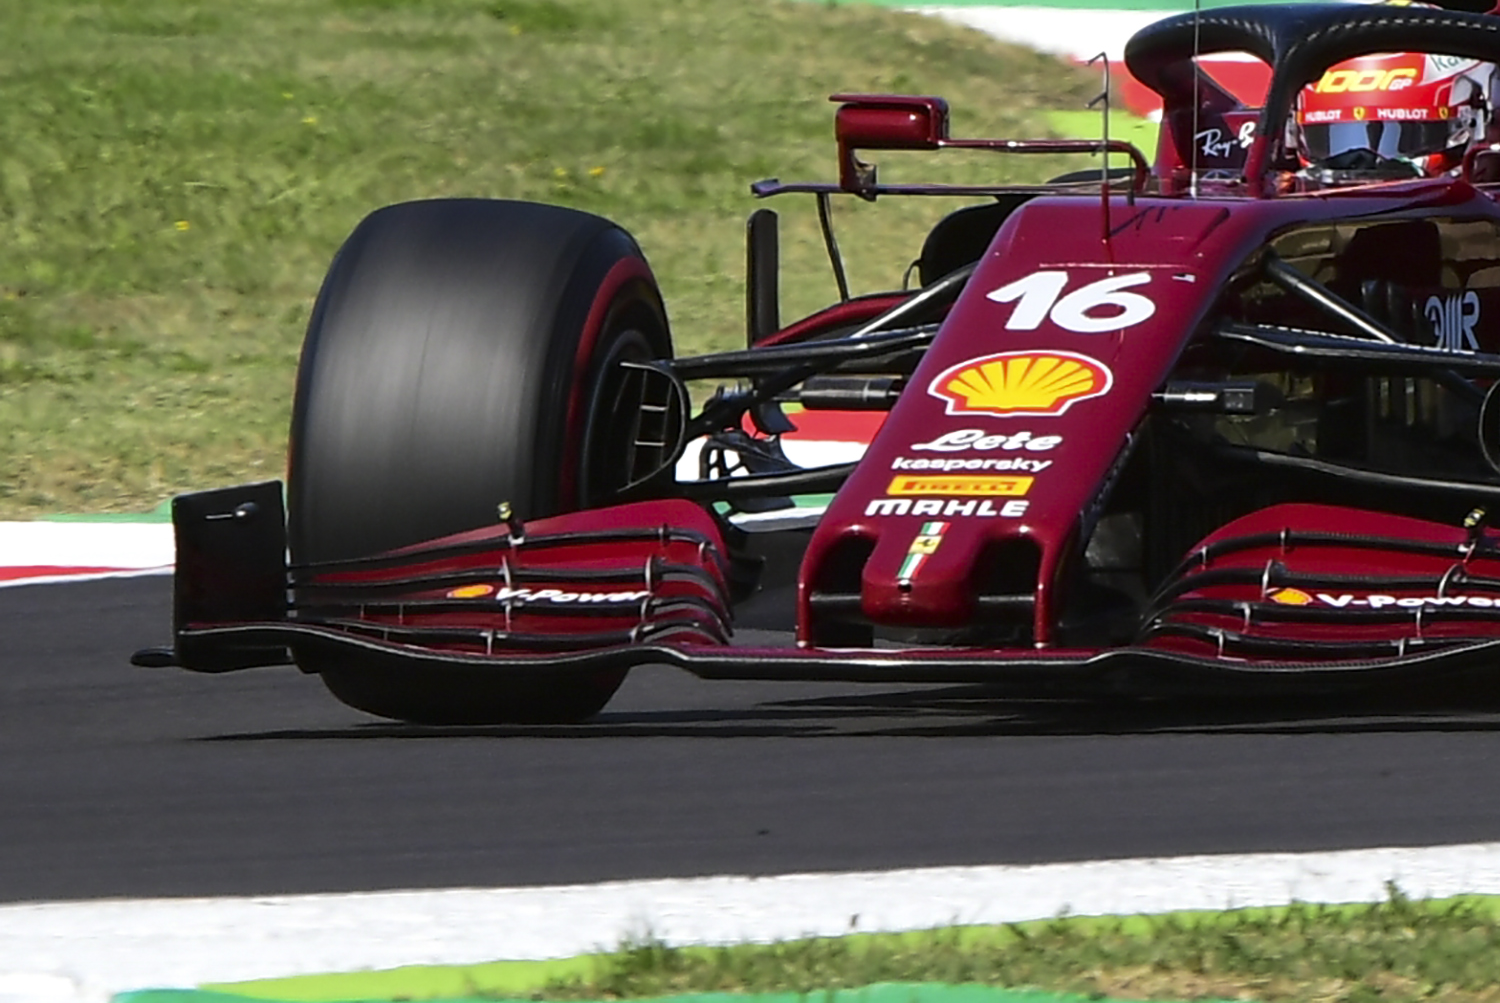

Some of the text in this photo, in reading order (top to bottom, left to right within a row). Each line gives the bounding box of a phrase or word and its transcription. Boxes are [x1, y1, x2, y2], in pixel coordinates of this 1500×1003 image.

[1305, 109, 1342, 121] HUBLOT
[1377, 108, 1428, 119] HUBLOT
[987, 270, 1156, 333] 16
[911, 429, 1063, 451] Lete
[891, 457, 1053, 472] kaspersky
[865, 500, 1029, 516] MAHLE
[496, 587, 652, 603] V-Power
